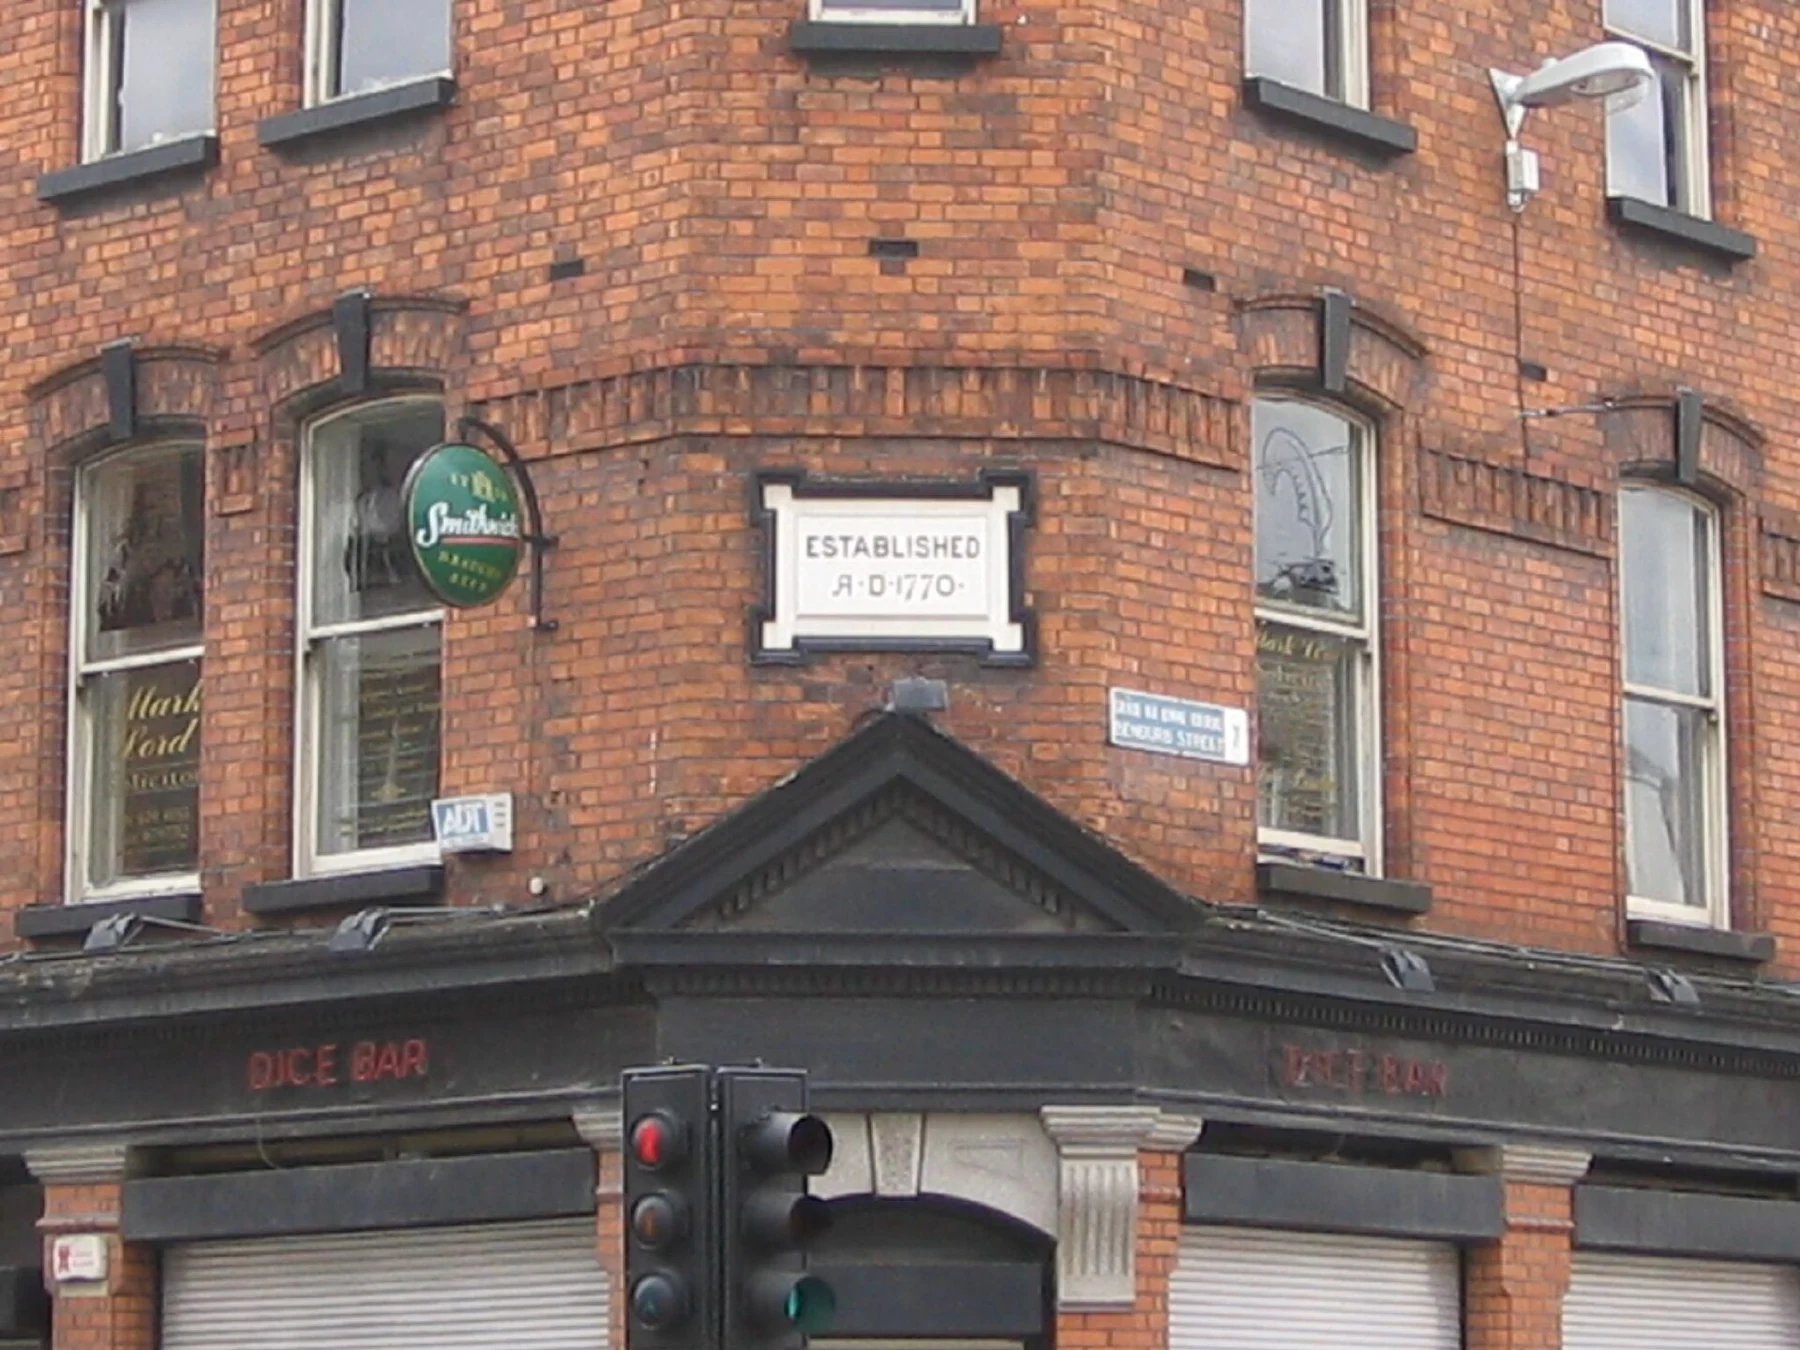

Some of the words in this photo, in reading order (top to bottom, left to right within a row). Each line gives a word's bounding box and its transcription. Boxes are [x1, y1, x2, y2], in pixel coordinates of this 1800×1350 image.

[806, 535, 981, 559] ESTABLISHED
[442, 804, 483, 836] ADT
[249, 1044, 338, 1090] DICE
[352, 1039, 427, 1082] BAR
